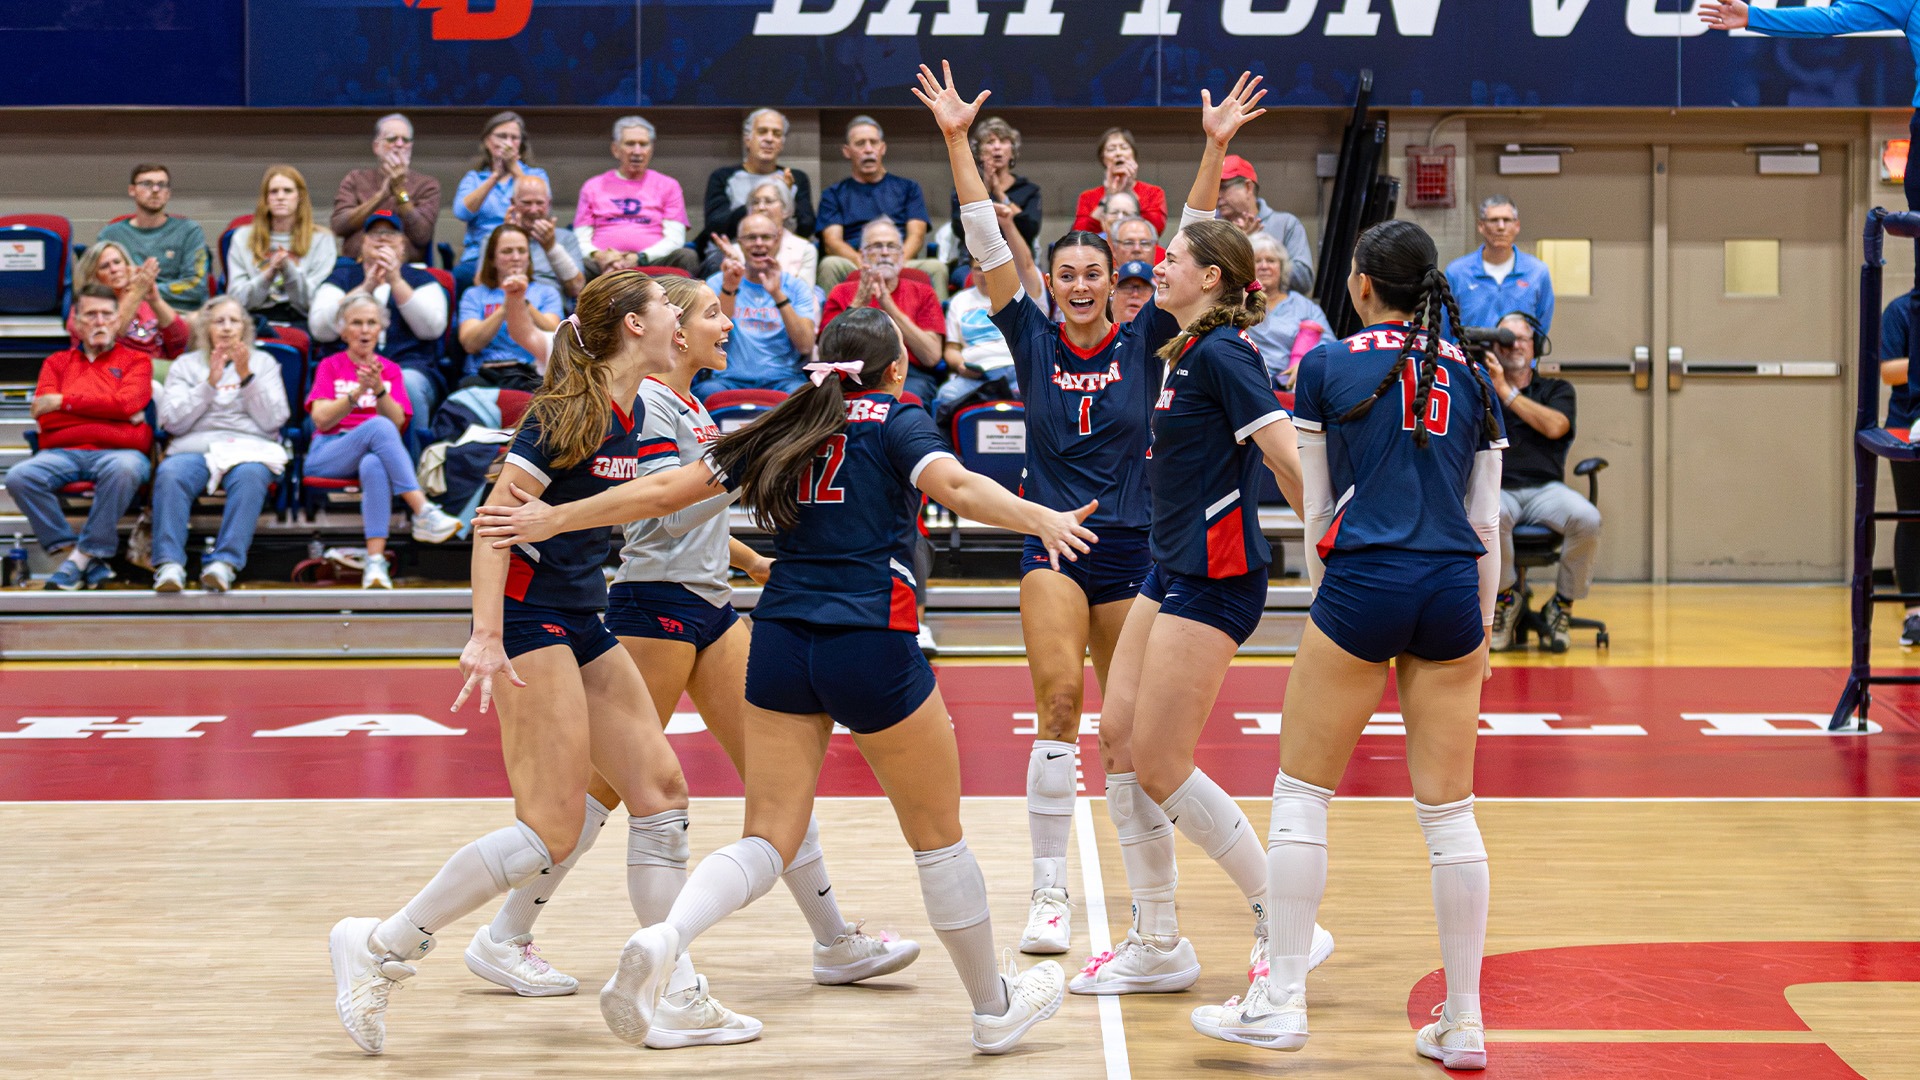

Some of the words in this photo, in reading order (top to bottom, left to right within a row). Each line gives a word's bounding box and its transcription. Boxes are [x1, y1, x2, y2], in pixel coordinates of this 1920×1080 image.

[1079, 396, 1093, 436] 1
[1399, 357, 1451, 436] 16
[593, 456, 639, 480] DAYTO
[797, 433, 848, 504] 12
